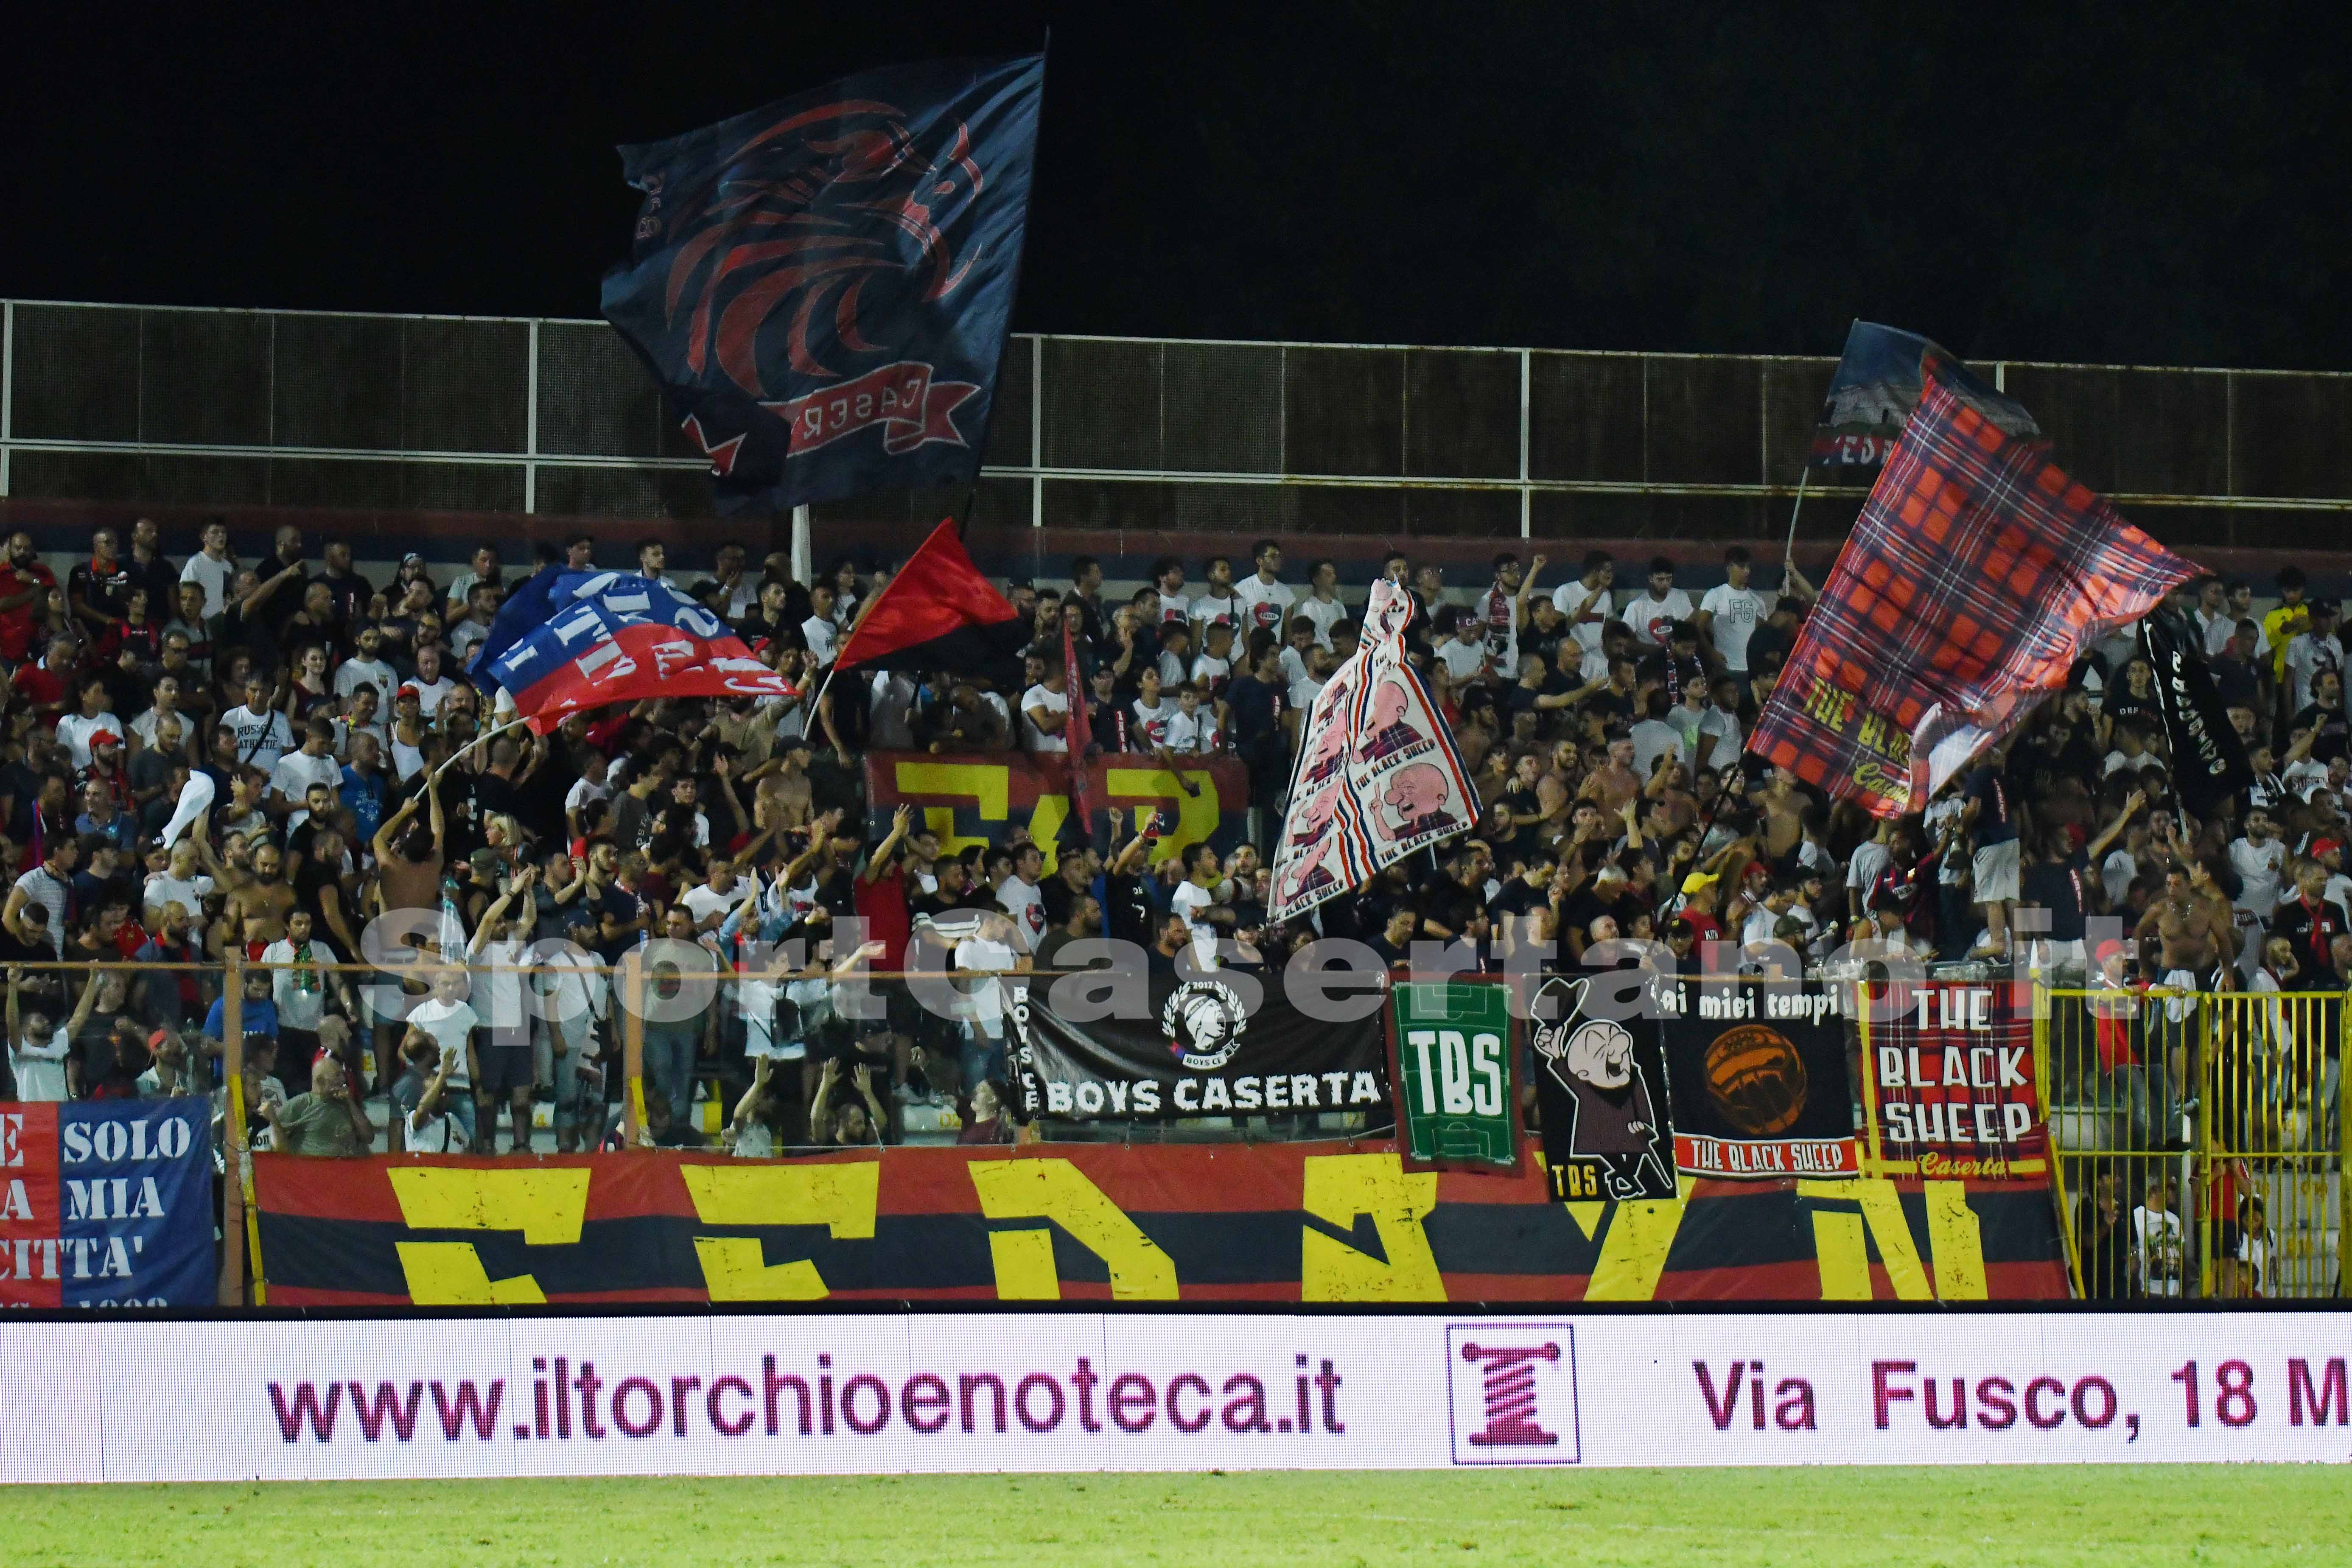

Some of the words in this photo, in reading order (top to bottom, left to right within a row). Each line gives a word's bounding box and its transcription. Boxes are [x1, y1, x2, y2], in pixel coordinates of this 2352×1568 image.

[1699, 987, 1756, 1019] miei
[1767, 984, 1829, 1026] tempi
[1911, 988, 1993, 1030] THE
[1187, 1056, 1210, 1066] BOYS
[1408, 1030, 1502, 1115] TBS
[1879, 1046, 2028, 1087] BLACK
[1047, 1079, 1161, 1113] BOYS
[1172, 1070, 1382, 1112] CASERTA
[64, 1117, 191, 1163] SOLO
[1884, 1102, 2032, 1142] SHEEP
[1691, 1140, 1721, 1170] THE
[1728, 1144, 1785, 1173] BLACK
[1792, 1142, 1843, 1171] SHEEP
[1918, 1151, 2007, 1176] Caserta
[67, 1176, 165, 1220] MIA
[1552, 1164, 1598, 1196] TBS
[268, 1354, 1344, 1443] www.iltorchioenoteca.it
[1693, 1359, 1817, 1431] Via
[1871, 1359, 2140, 1443] Fusco,
[2171, 1358, 2257, 1428] 18
